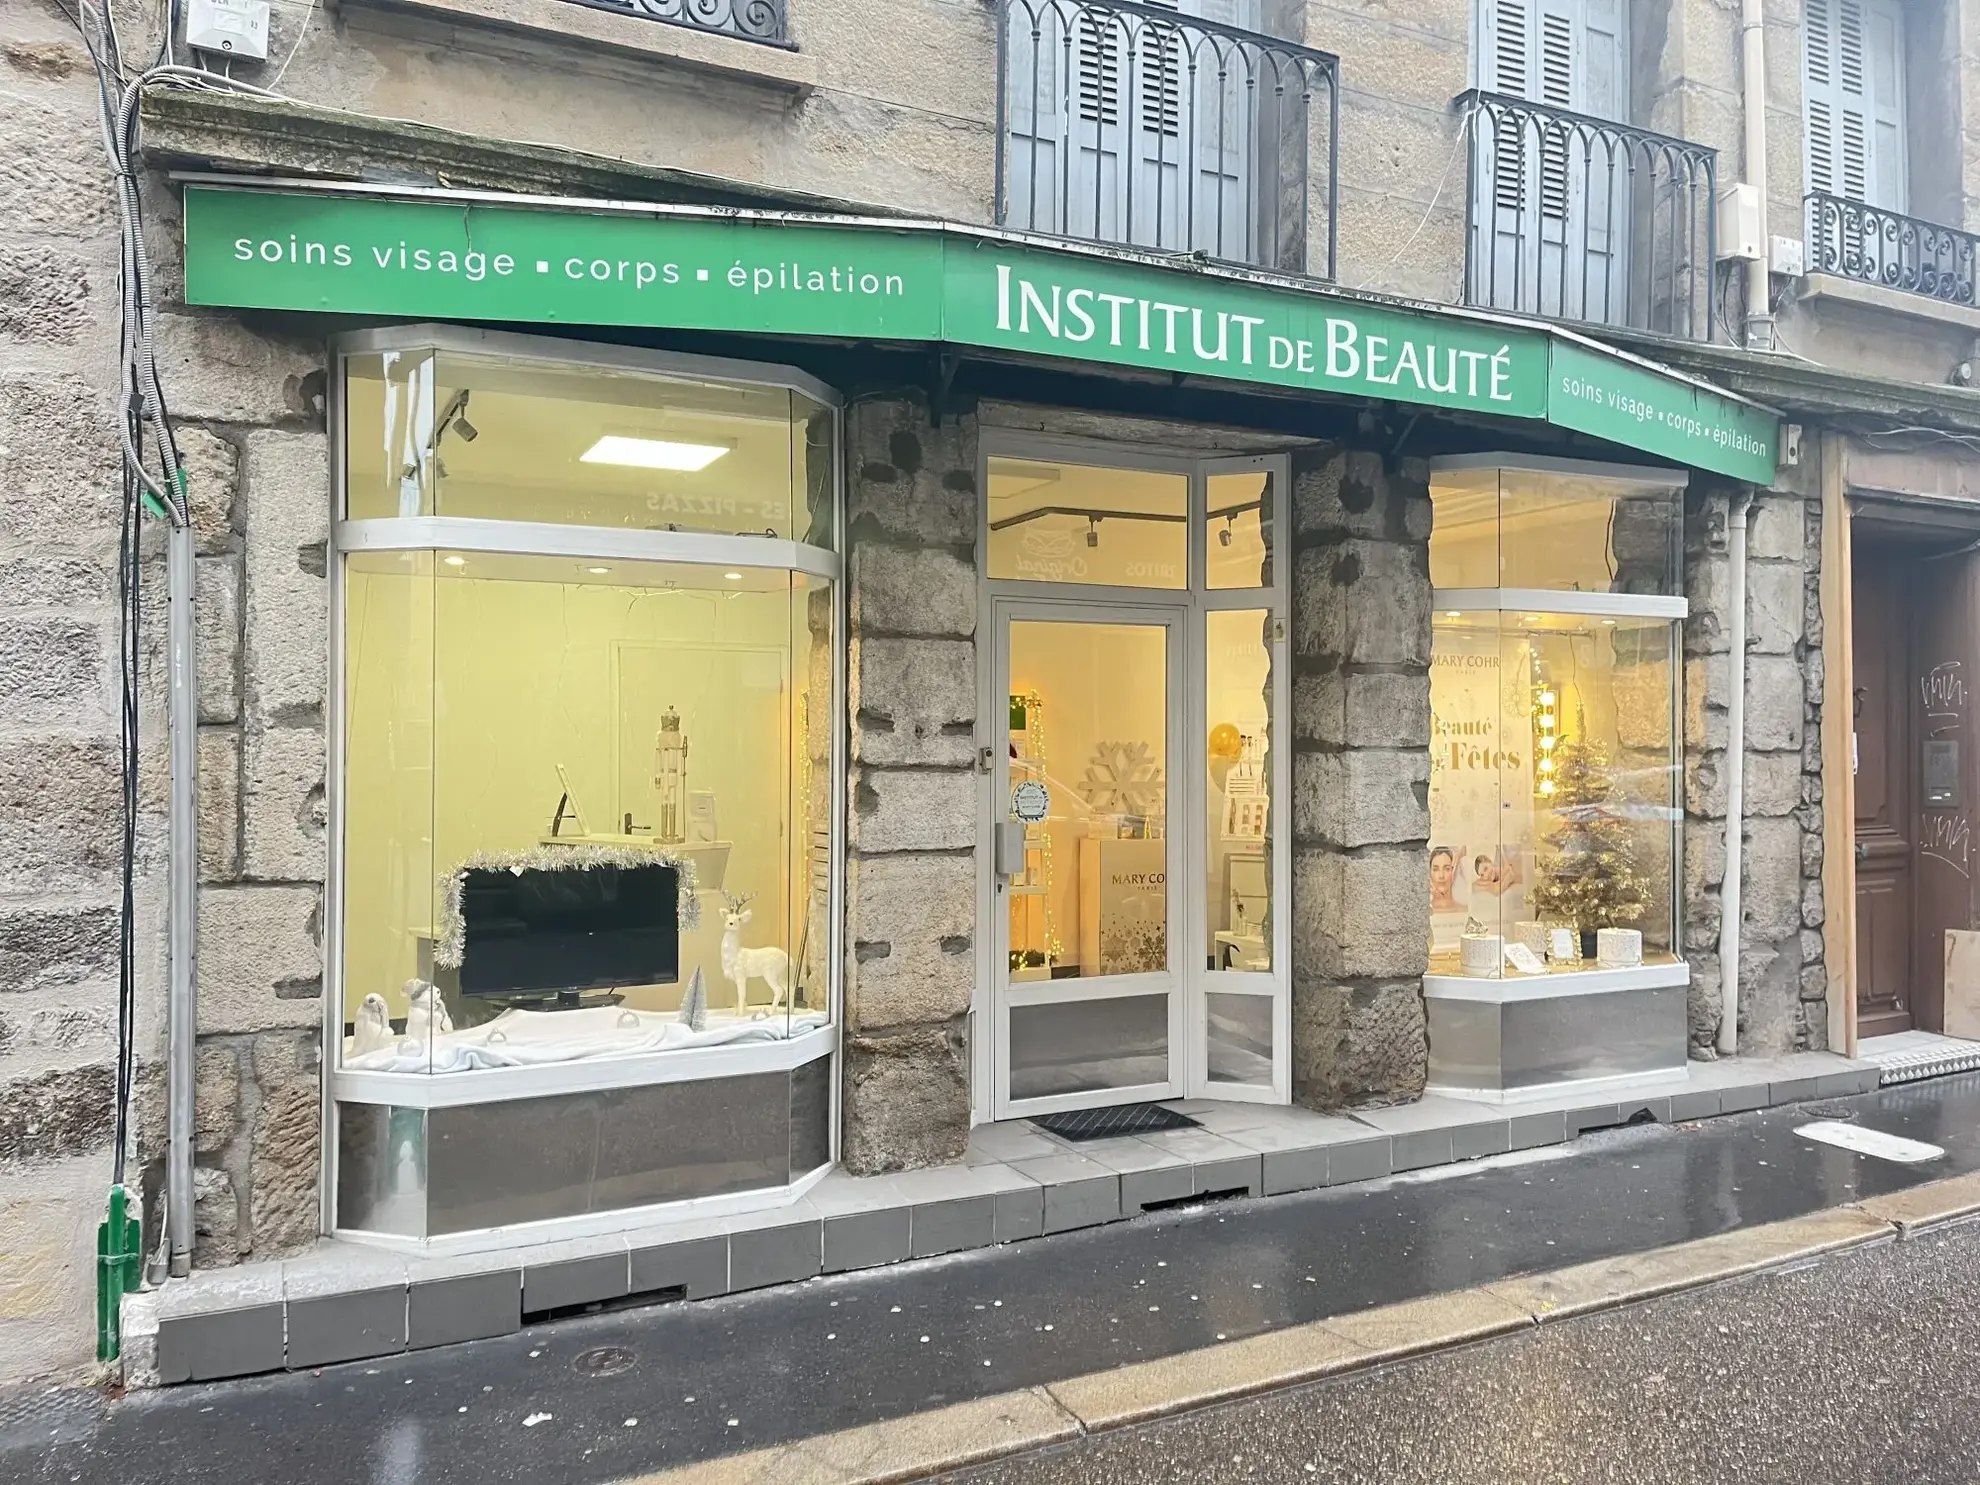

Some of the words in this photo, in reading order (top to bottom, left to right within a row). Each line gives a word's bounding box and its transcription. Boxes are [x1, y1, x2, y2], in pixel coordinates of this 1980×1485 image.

[234, 234, 352, 268] soins
[372, 241, 516, 281] visage
[564, 258, 679, 290] corps
[727, 260, 904, 296] épilation
[996, 265, 1265, 366] INSTITUT
[1269, 336, 1315, 373] DE
[1325, 318, 1513, 401] BEAUTÉ
[1562, 376, 1603, 404] soins
[1608, 390, 1654, 423] visage
[1666, 411, 1702, 439] corps
[1712, 424, 1767, 458] épilation
[1432, 654, 1465, 668] MARY
[1466, 655, 1500, 668] COHR
[1450, 742, 1520, 770] Fêtes
[1112, 873, 1146, 885] MARY
